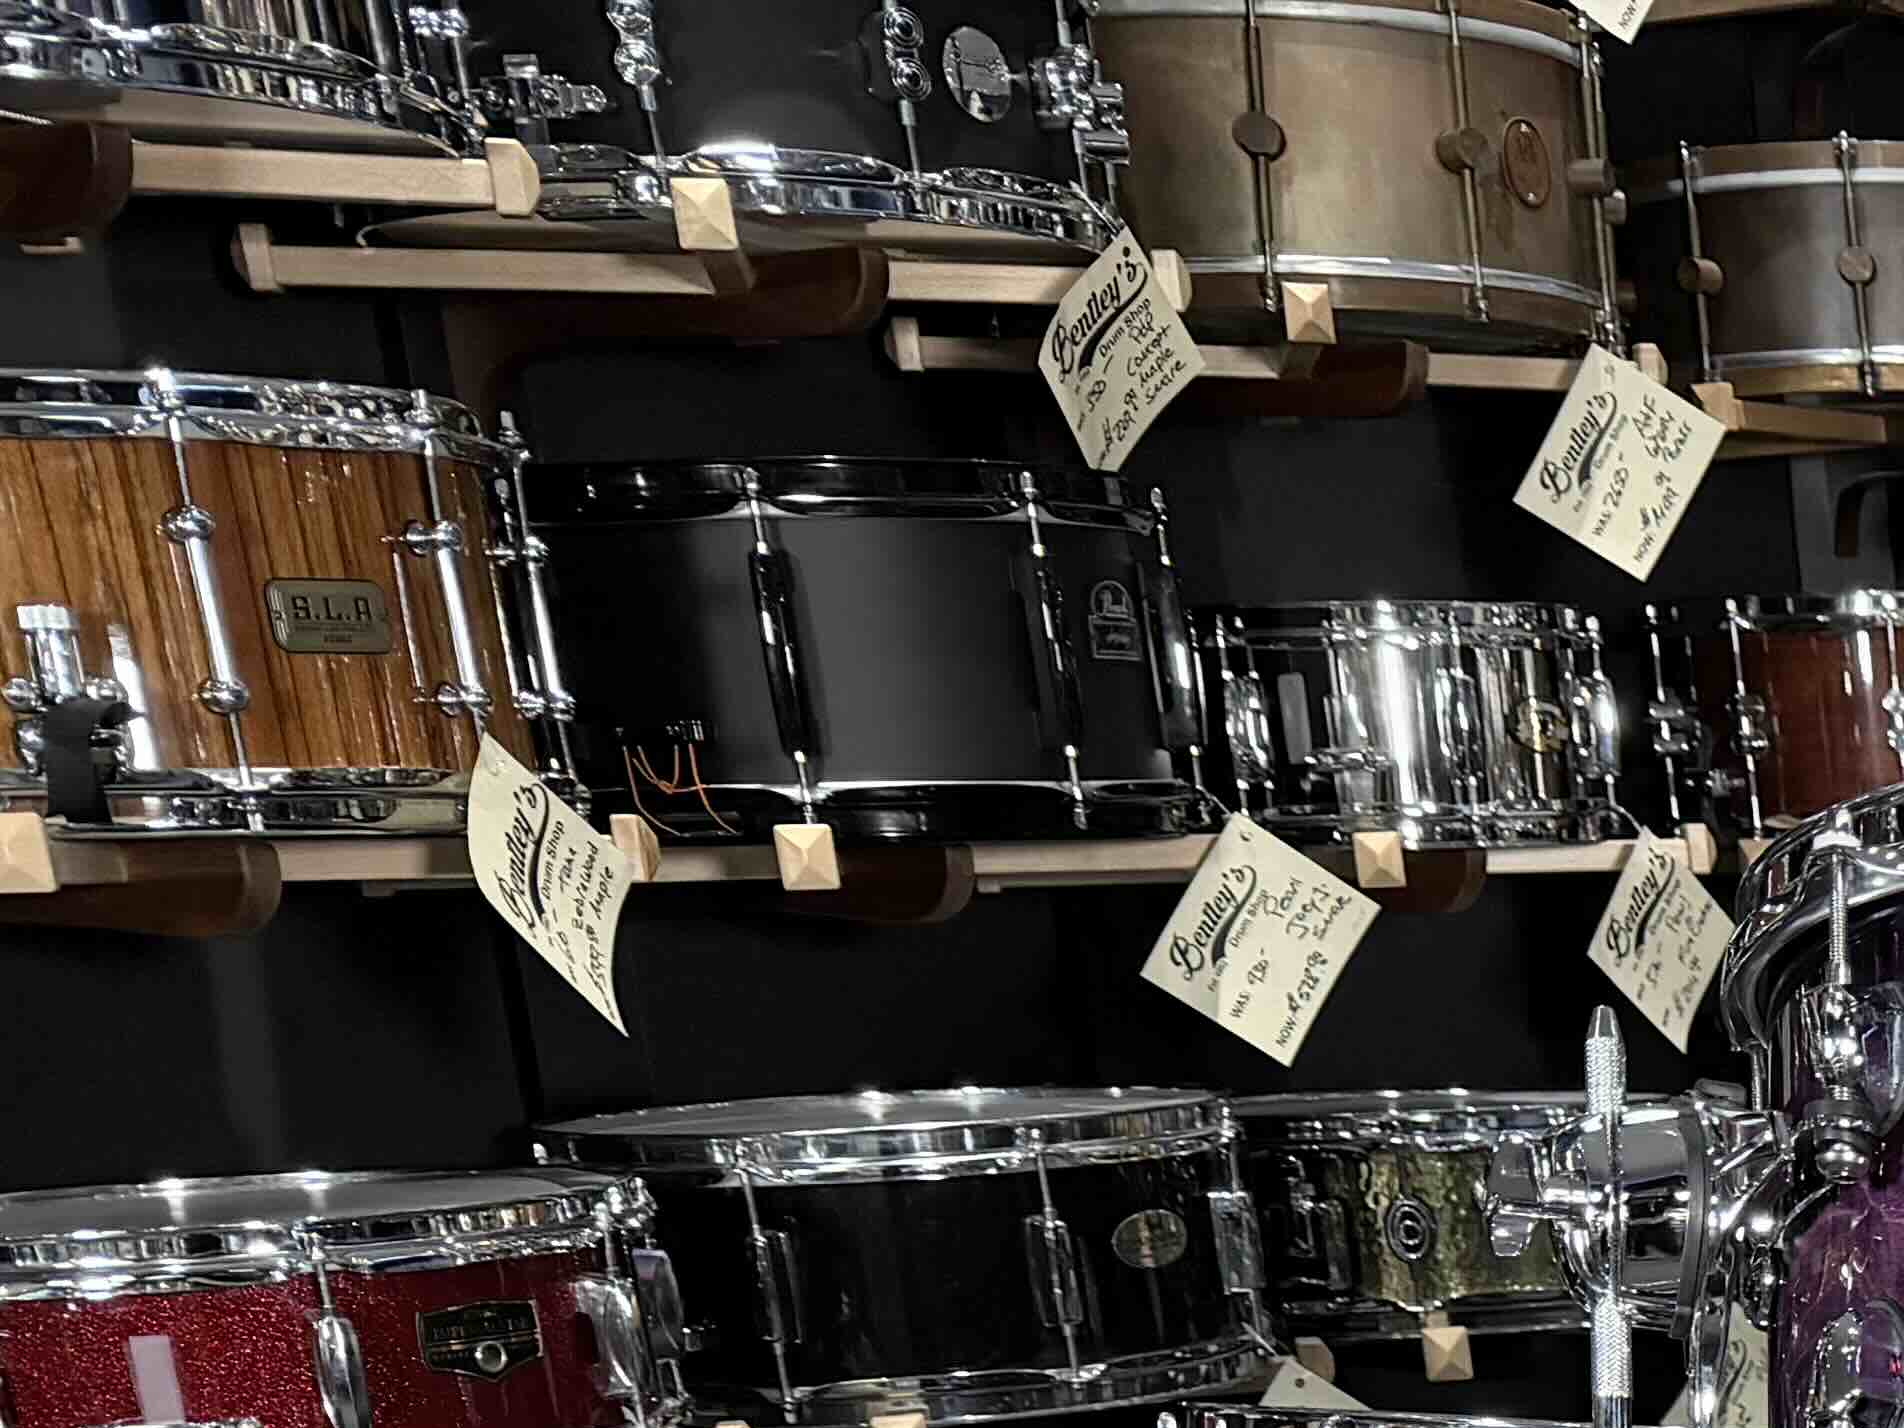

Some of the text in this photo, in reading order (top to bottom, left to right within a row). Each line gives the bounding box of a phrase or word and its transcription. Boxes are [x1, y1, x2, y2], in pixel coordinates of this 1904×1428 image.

[1052, 260, 1147, 383] Bentley's
[1099, 298, 1151, 357] Drum Shop
[1540, 391, 1616, 503] Bentley's
[494, 782, 548, 938] Bentley's
[541, 820, 566, 900] Drum Shop
[1605, 850, 1672, 967] Bentley's
[1170, 865, 1256, 982] Bentley's
